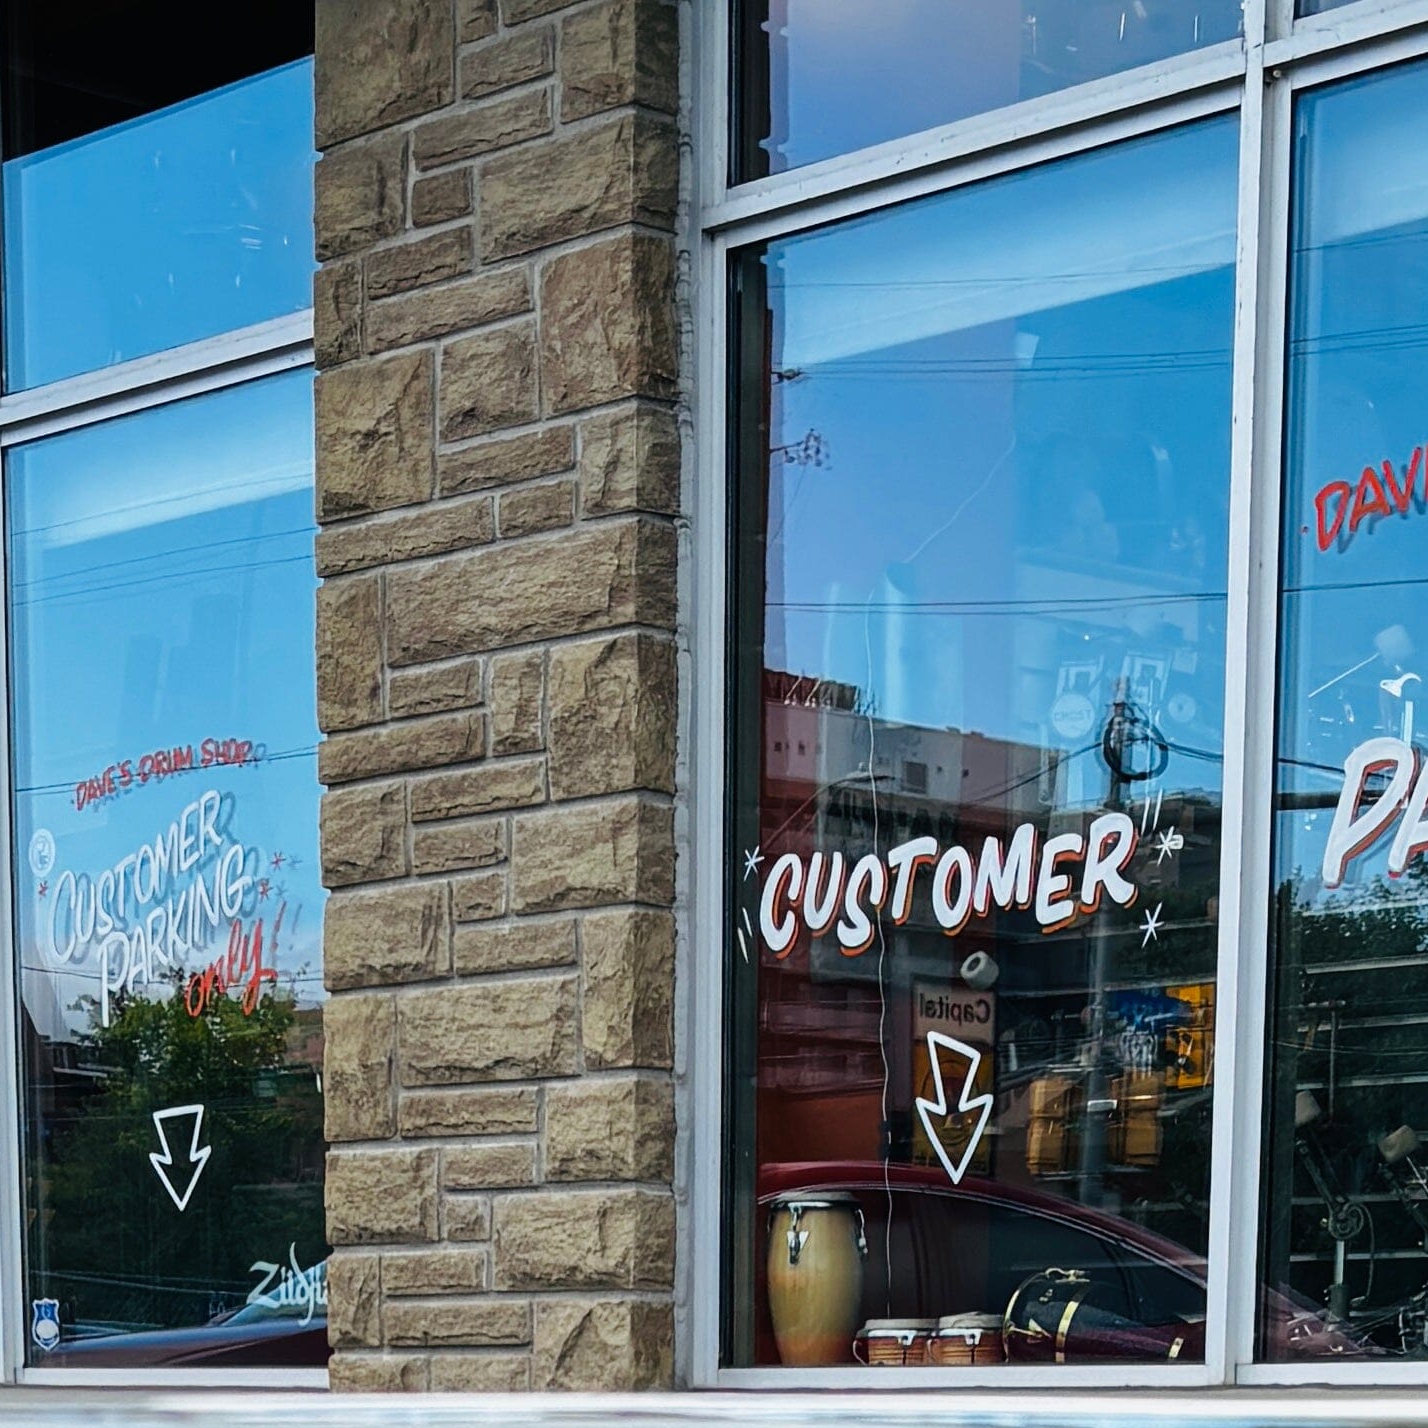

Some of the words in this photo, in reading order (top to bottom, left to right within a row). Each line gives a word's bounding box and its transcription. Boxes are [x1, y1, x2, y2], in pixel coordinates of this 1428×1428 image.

[76, 759, 133, 811] DAVE'S
[138, 744, 193, 782] DRUM
[200, 738, 253, 766] SHOP
[49, 790, 222, 964] CUSTOMER
[99, 844, 253, 1028] PARKING
[759, 812, 1139, 957] CUSTOMER
[246, 1241, 328, 1327] Zildji
